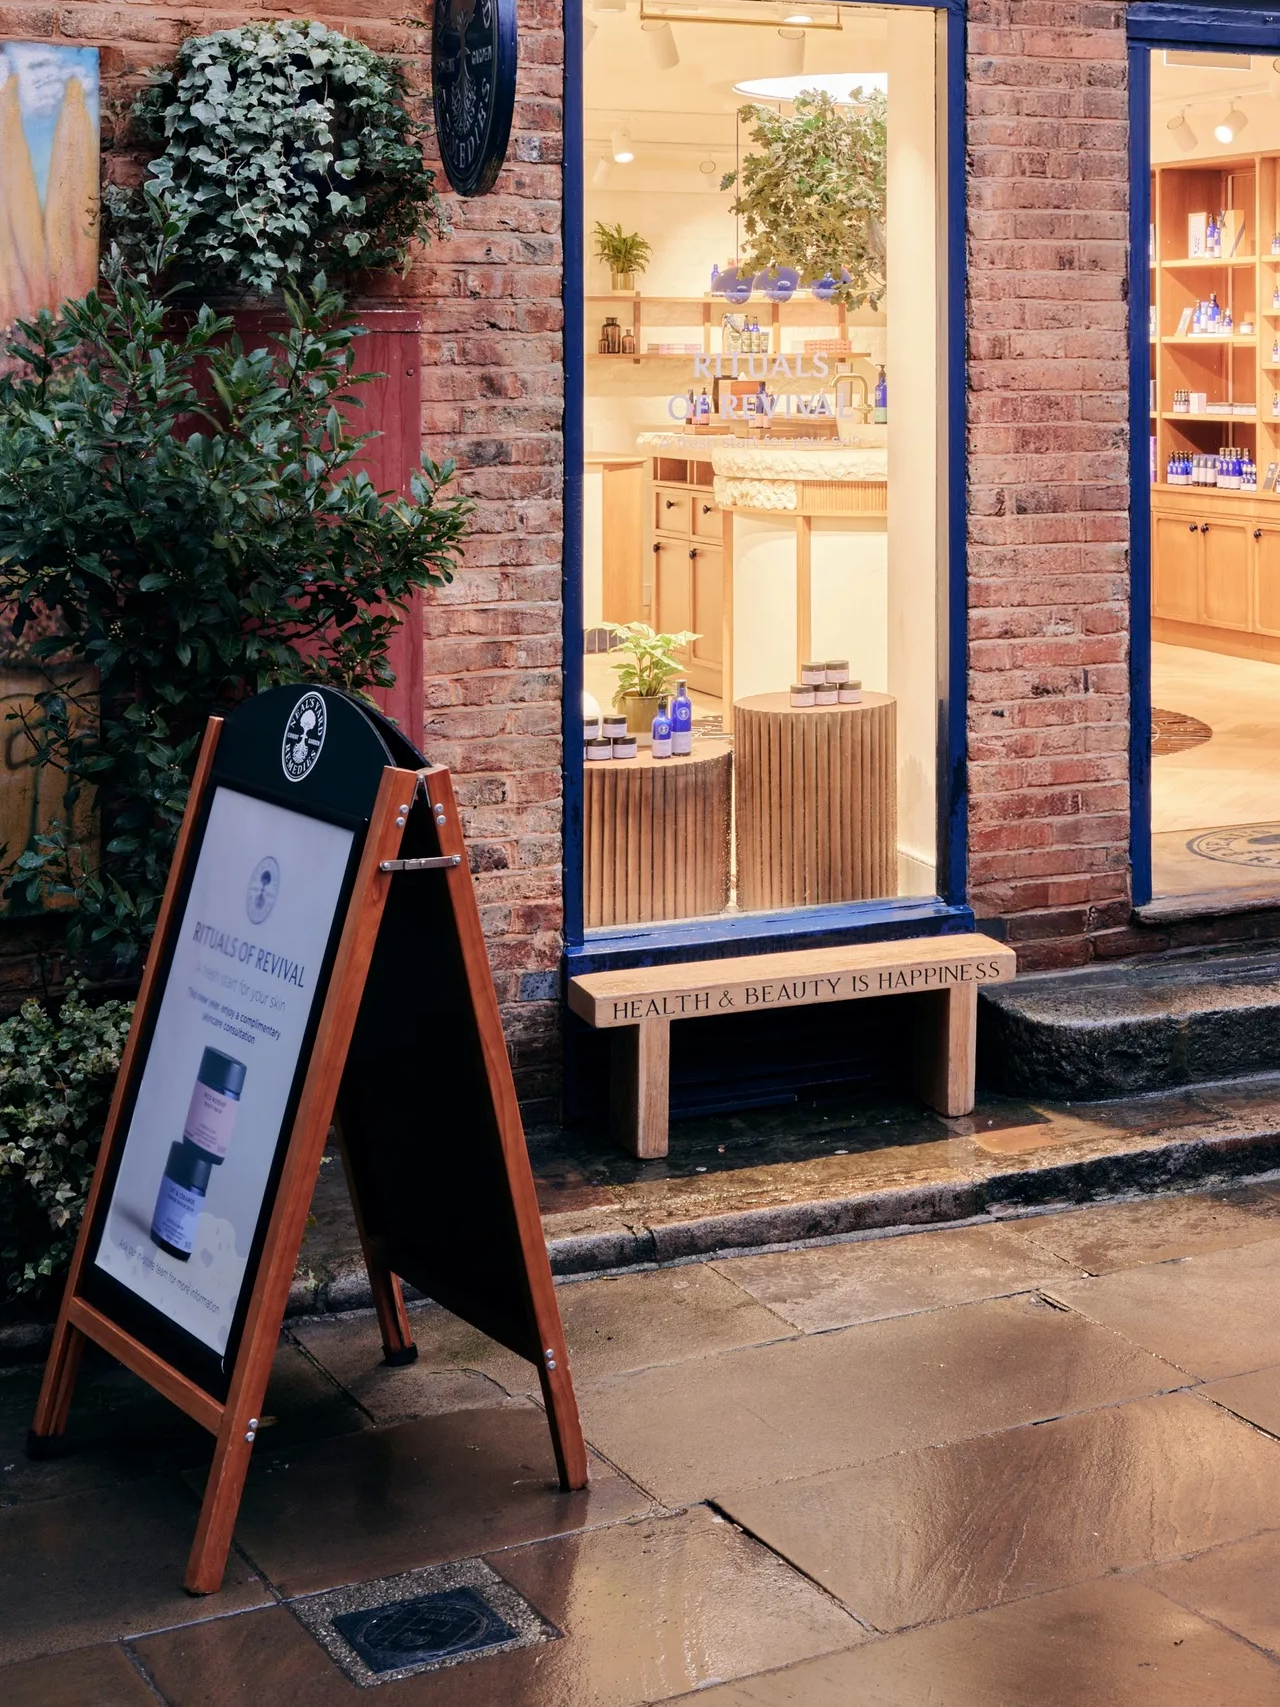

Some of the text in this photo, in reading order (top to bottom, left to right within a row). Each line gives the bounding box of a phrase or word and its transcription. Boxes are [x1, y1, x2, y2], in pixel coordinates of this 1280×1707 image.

[693, 352, 830, 379] RITUALS
[667, 393, 854, 420] OF REVIVAL
[722, 435, 759, 449] start
[764, 434, 785, 447] for
[790, 436, 826, 450] your
[831, 434, 862, 447] skin
[290, 698, 323, 736] NEAL'S YARD
[285, 743, 316, 775] REMEDIES
[192, 921, 305, 988] RITUALS OF REVIVAL
[239, 979, 251, 996] for
[250, 988, 269, 1004] your
[269, 996, 286, 1012] skin
[613, 961, 1001, 1021] HEALTH & BEAUTY IS HAPPINESS
[221, 1004, 236, 1019] enjoy
[240, 1014, 282, 1041] complimentary
[223, 1022, 256, 1045] consultation
[155, 1263, 169, 1277] team
[169, 1272, 177, 1284] for
[177, 1279, 191, 1295] more
[190, 1289, 220, 1313] information
